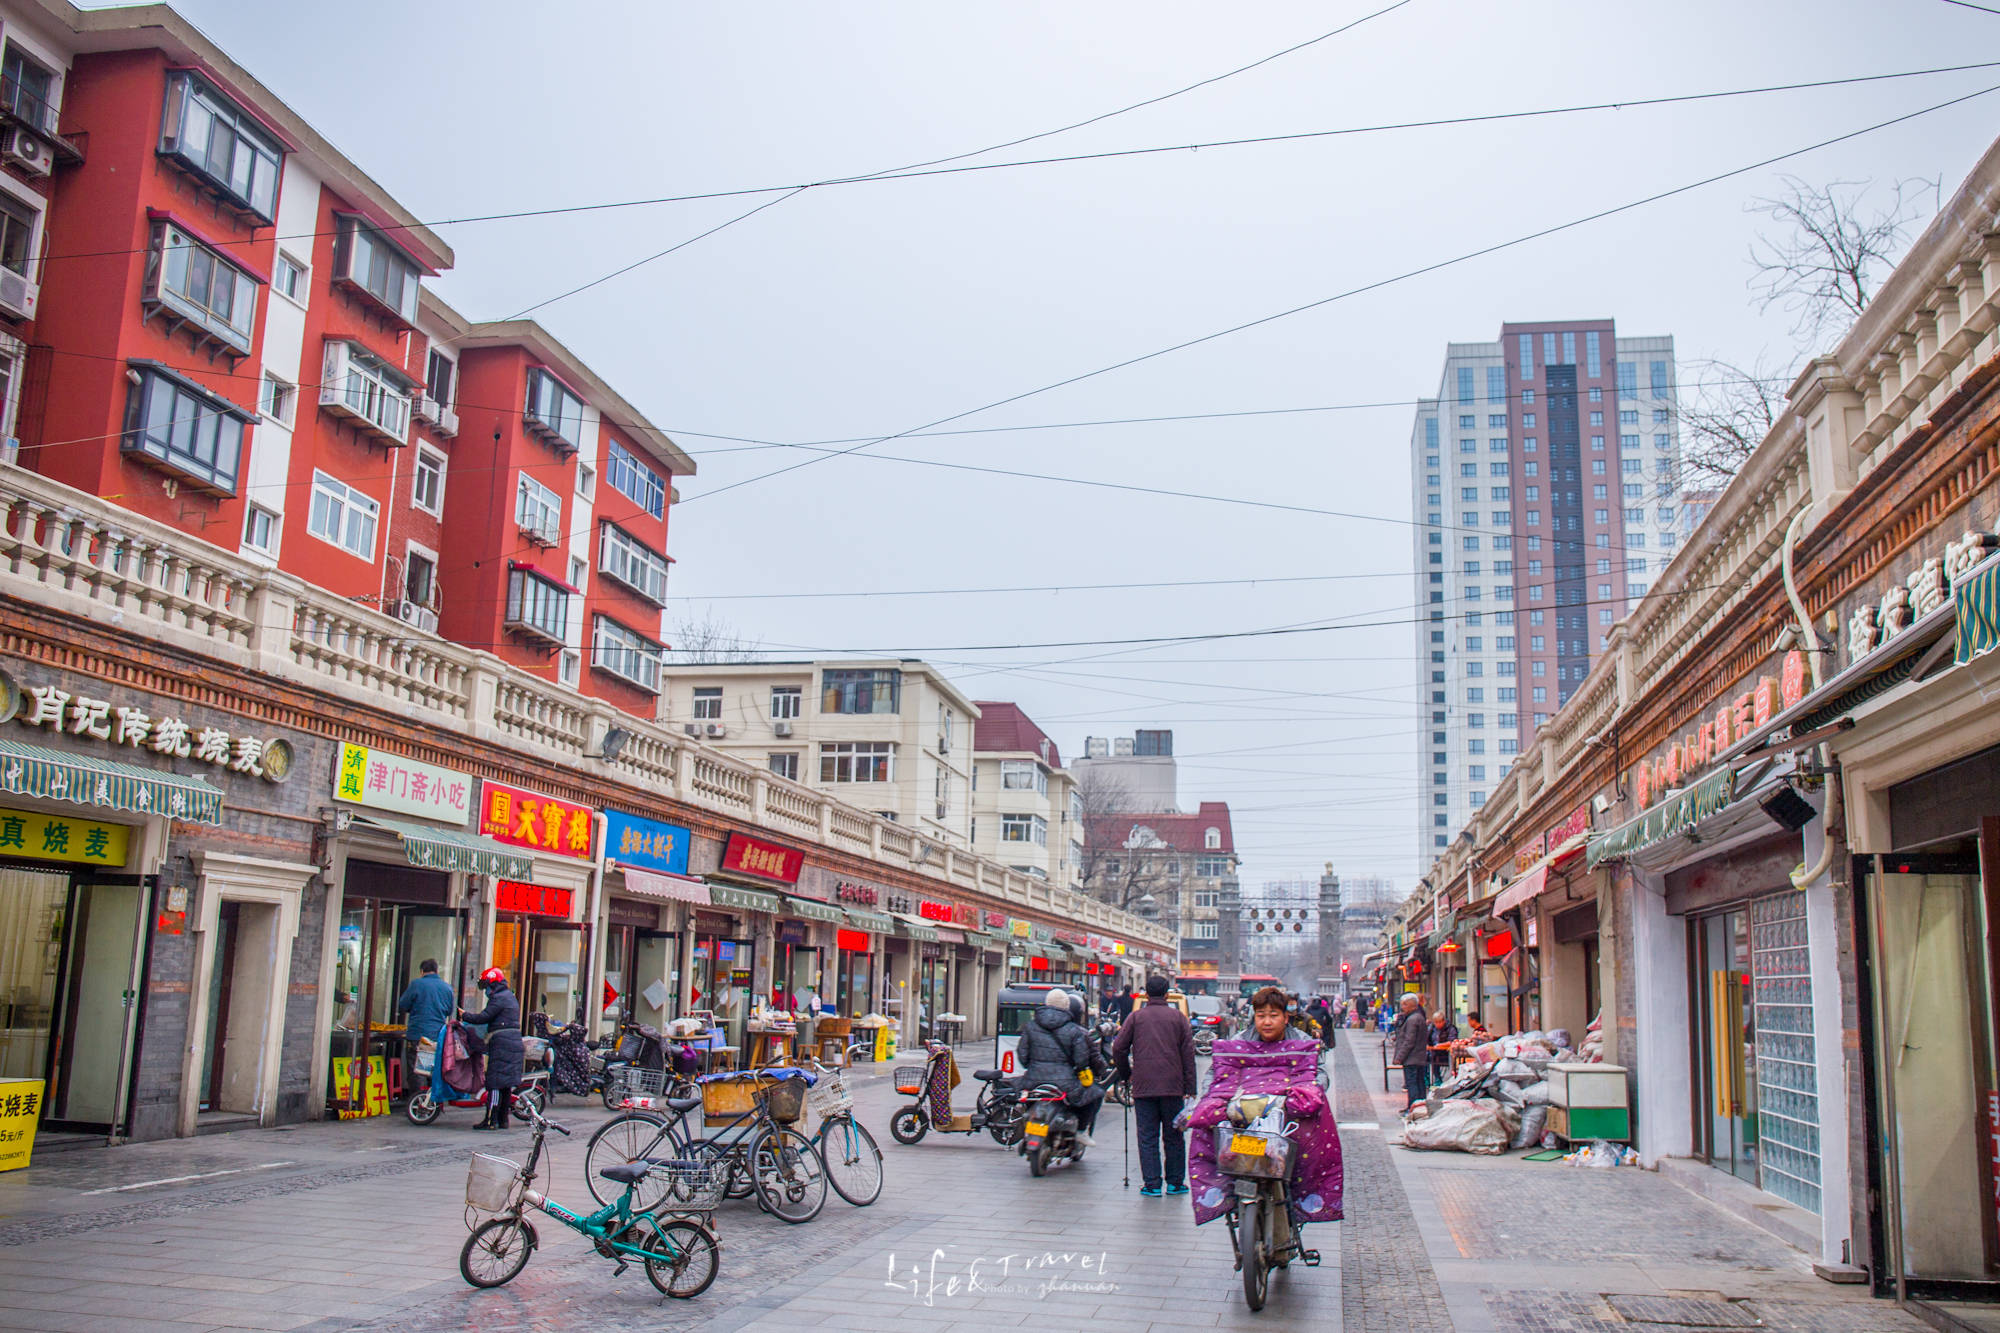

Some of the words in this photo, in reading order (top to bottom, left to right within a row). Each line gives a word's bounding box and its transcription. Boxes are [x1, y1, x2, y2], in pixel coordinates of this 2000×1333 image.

[31, 686, 264, 777] 肖记传统烧麦
[342, 749, 365, 797] 清真
[368, 761, 466, 811] 津门斋小吃
[0, 1092, 38, 1118] 烧麦
